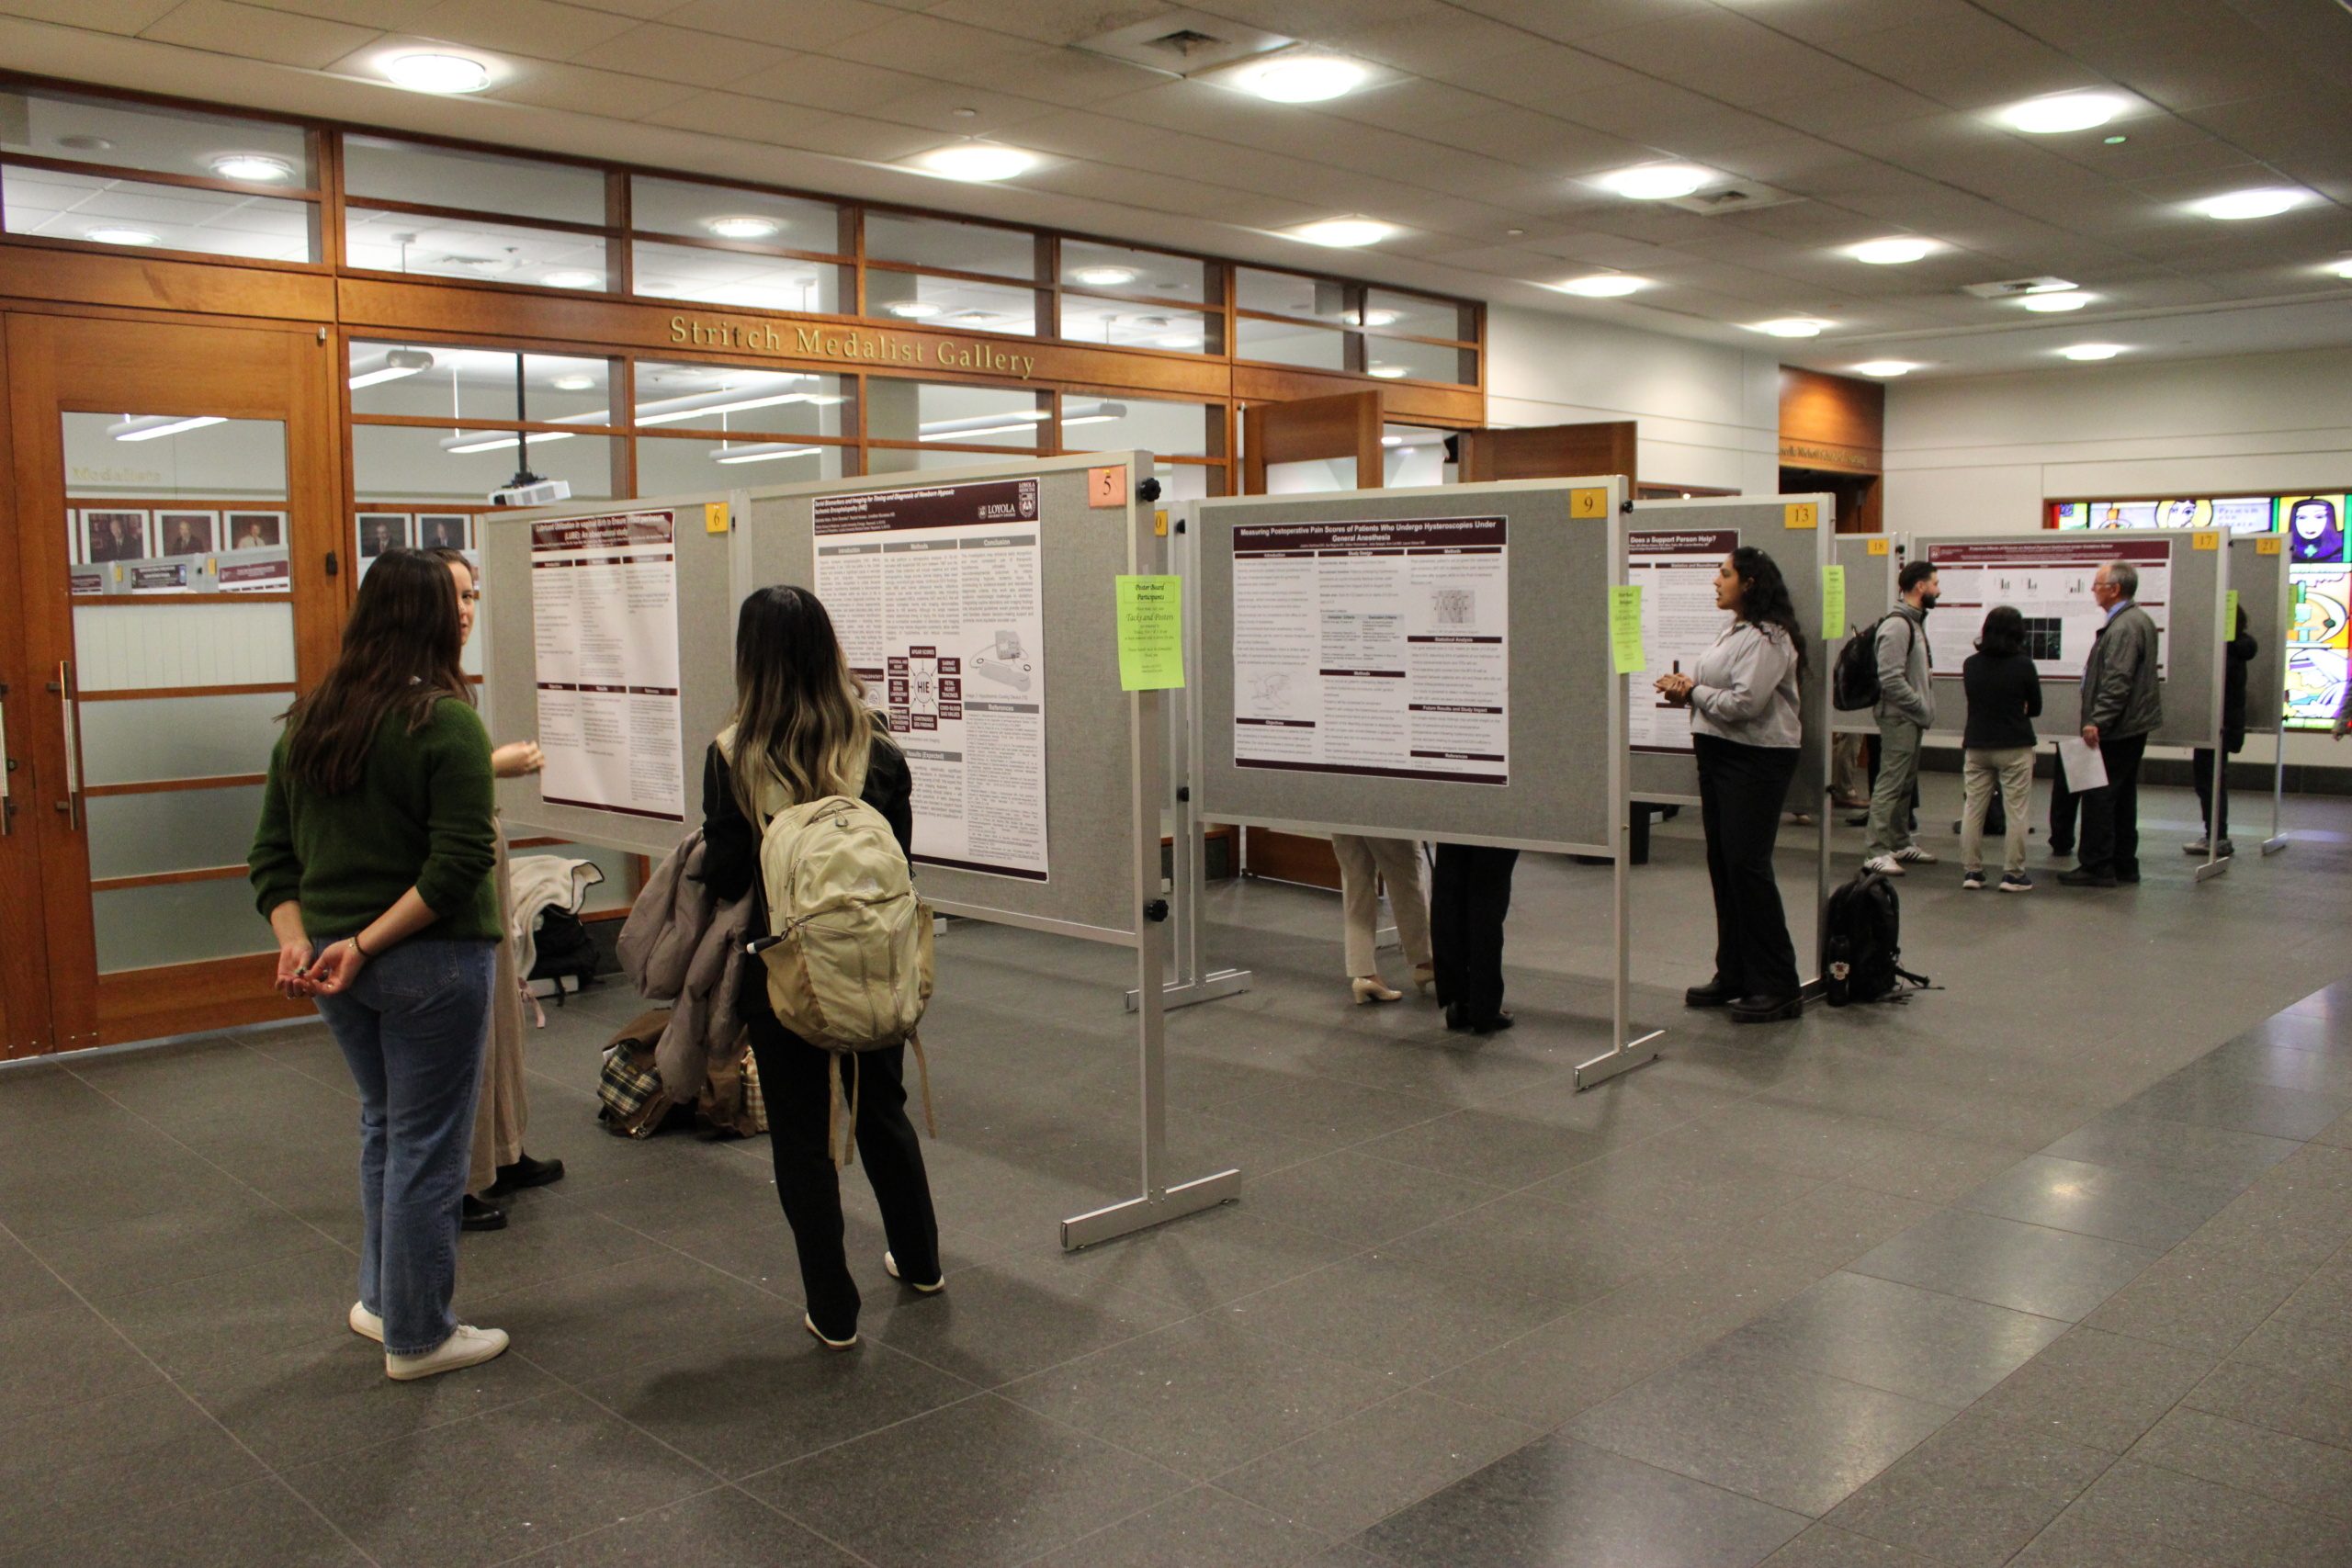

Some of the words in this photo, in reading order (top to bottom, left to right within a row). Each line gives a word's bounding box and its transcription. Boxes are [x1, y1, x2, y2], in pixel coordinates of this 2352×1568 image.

[671, 316, 779, 351] Stritch
[796, 327, 924, 362] Medalist
[937, 342, 1035, 380] Gallery
[1102, 476, 1111, 495] 5
[895, 492, 913, 501] Diagnosis
[988, 503, 1015, 514] LOYOLA
[1584, 496, 1593, 513] 9
[713, 510, 720, 526] 6
[1795, 509, 1808, 522] 13
[1241, 528, 1270, 536] Measuring
[1271, 526, 1309, 535] Postoperative
[1354, 524, 1379, 532] Patients
[1396, 523, 1423, 532] Undergo
[1424, 521, 1473, 532] Hysteroscopies
[1874, 542, 1883, 550] 18
[2199, 536, 2212, 545] 17
[2263, 542, 2273, 550] 21
[1137, 594, 1164, 603] Participants
[1126, 613, 1142, 622] Tacks
[1143, 613, 1153, 621] and
[917, 682, 930, 693] HIE
[922, 751, 944, 760] (Expected)
